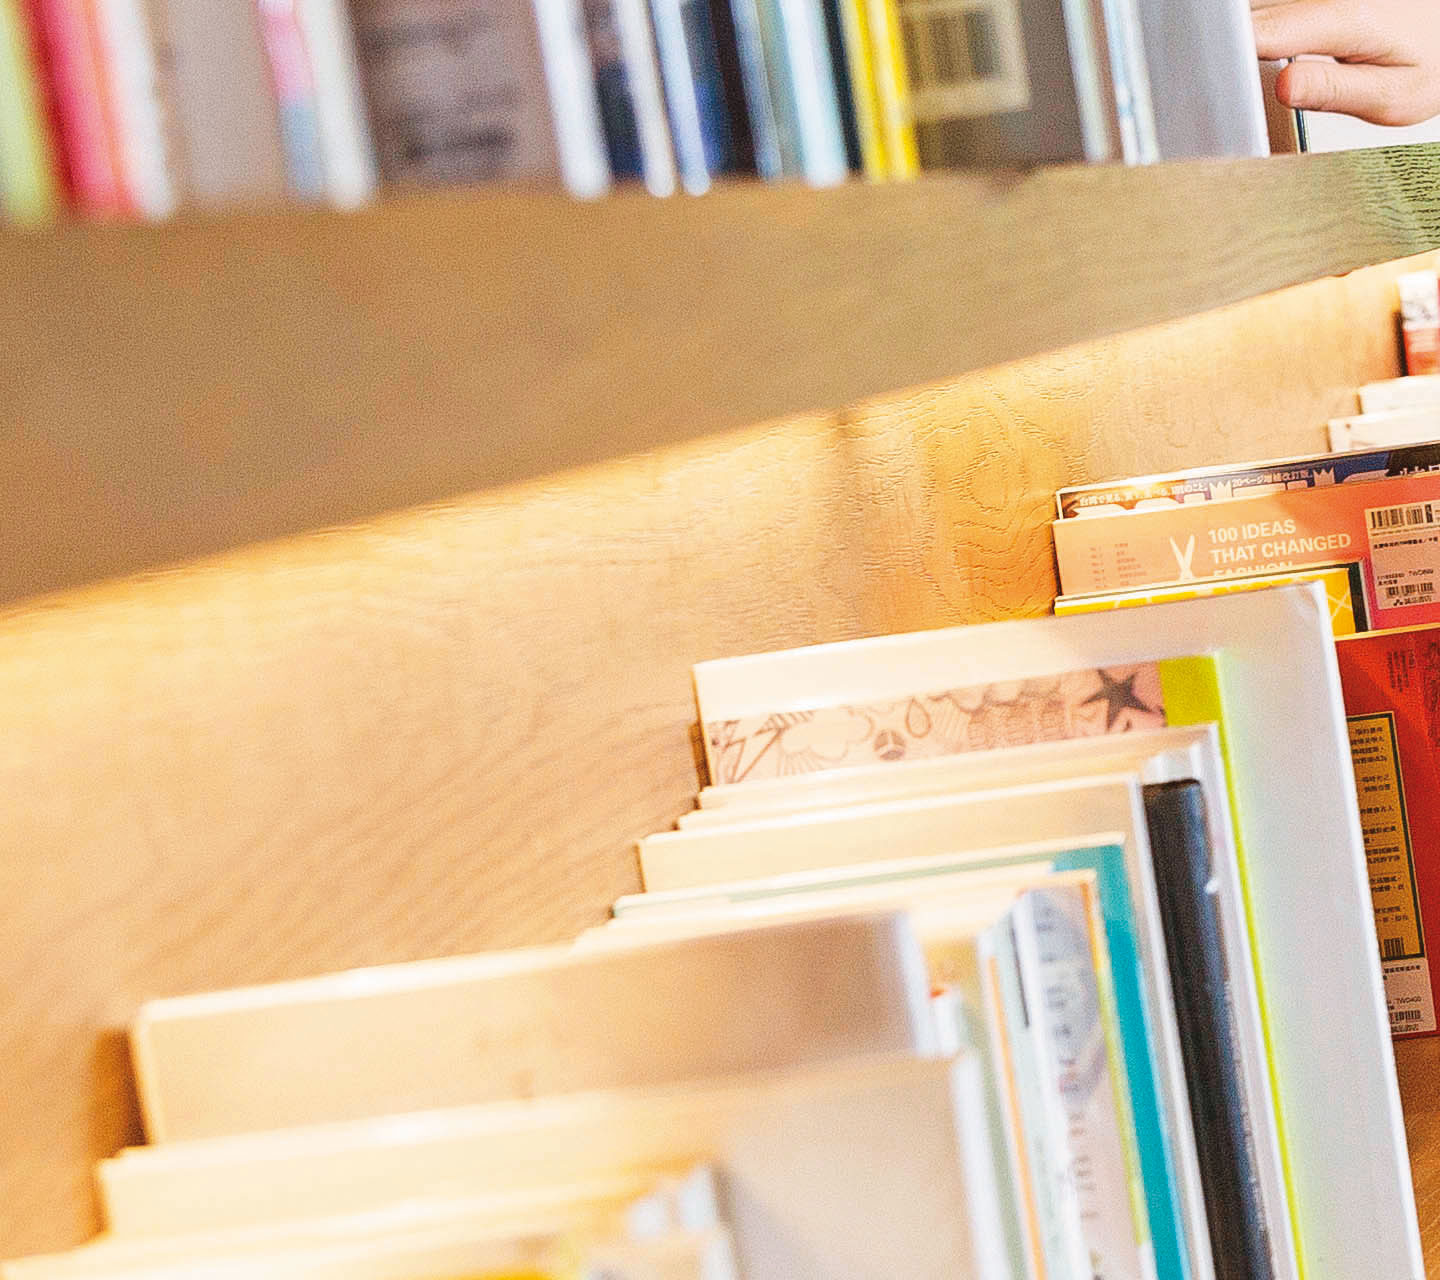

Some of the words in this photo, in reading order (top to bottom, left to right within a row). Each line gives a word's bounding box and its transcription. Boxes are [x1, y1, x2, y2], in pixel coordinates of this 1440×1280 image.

[1208, 528, 1238, 542] 100
[1242, 519, 1296, 540] IDEAS
[1209, 545, 1260, 564] THAT
[1264, 533, 1351, 560] CHANGED
